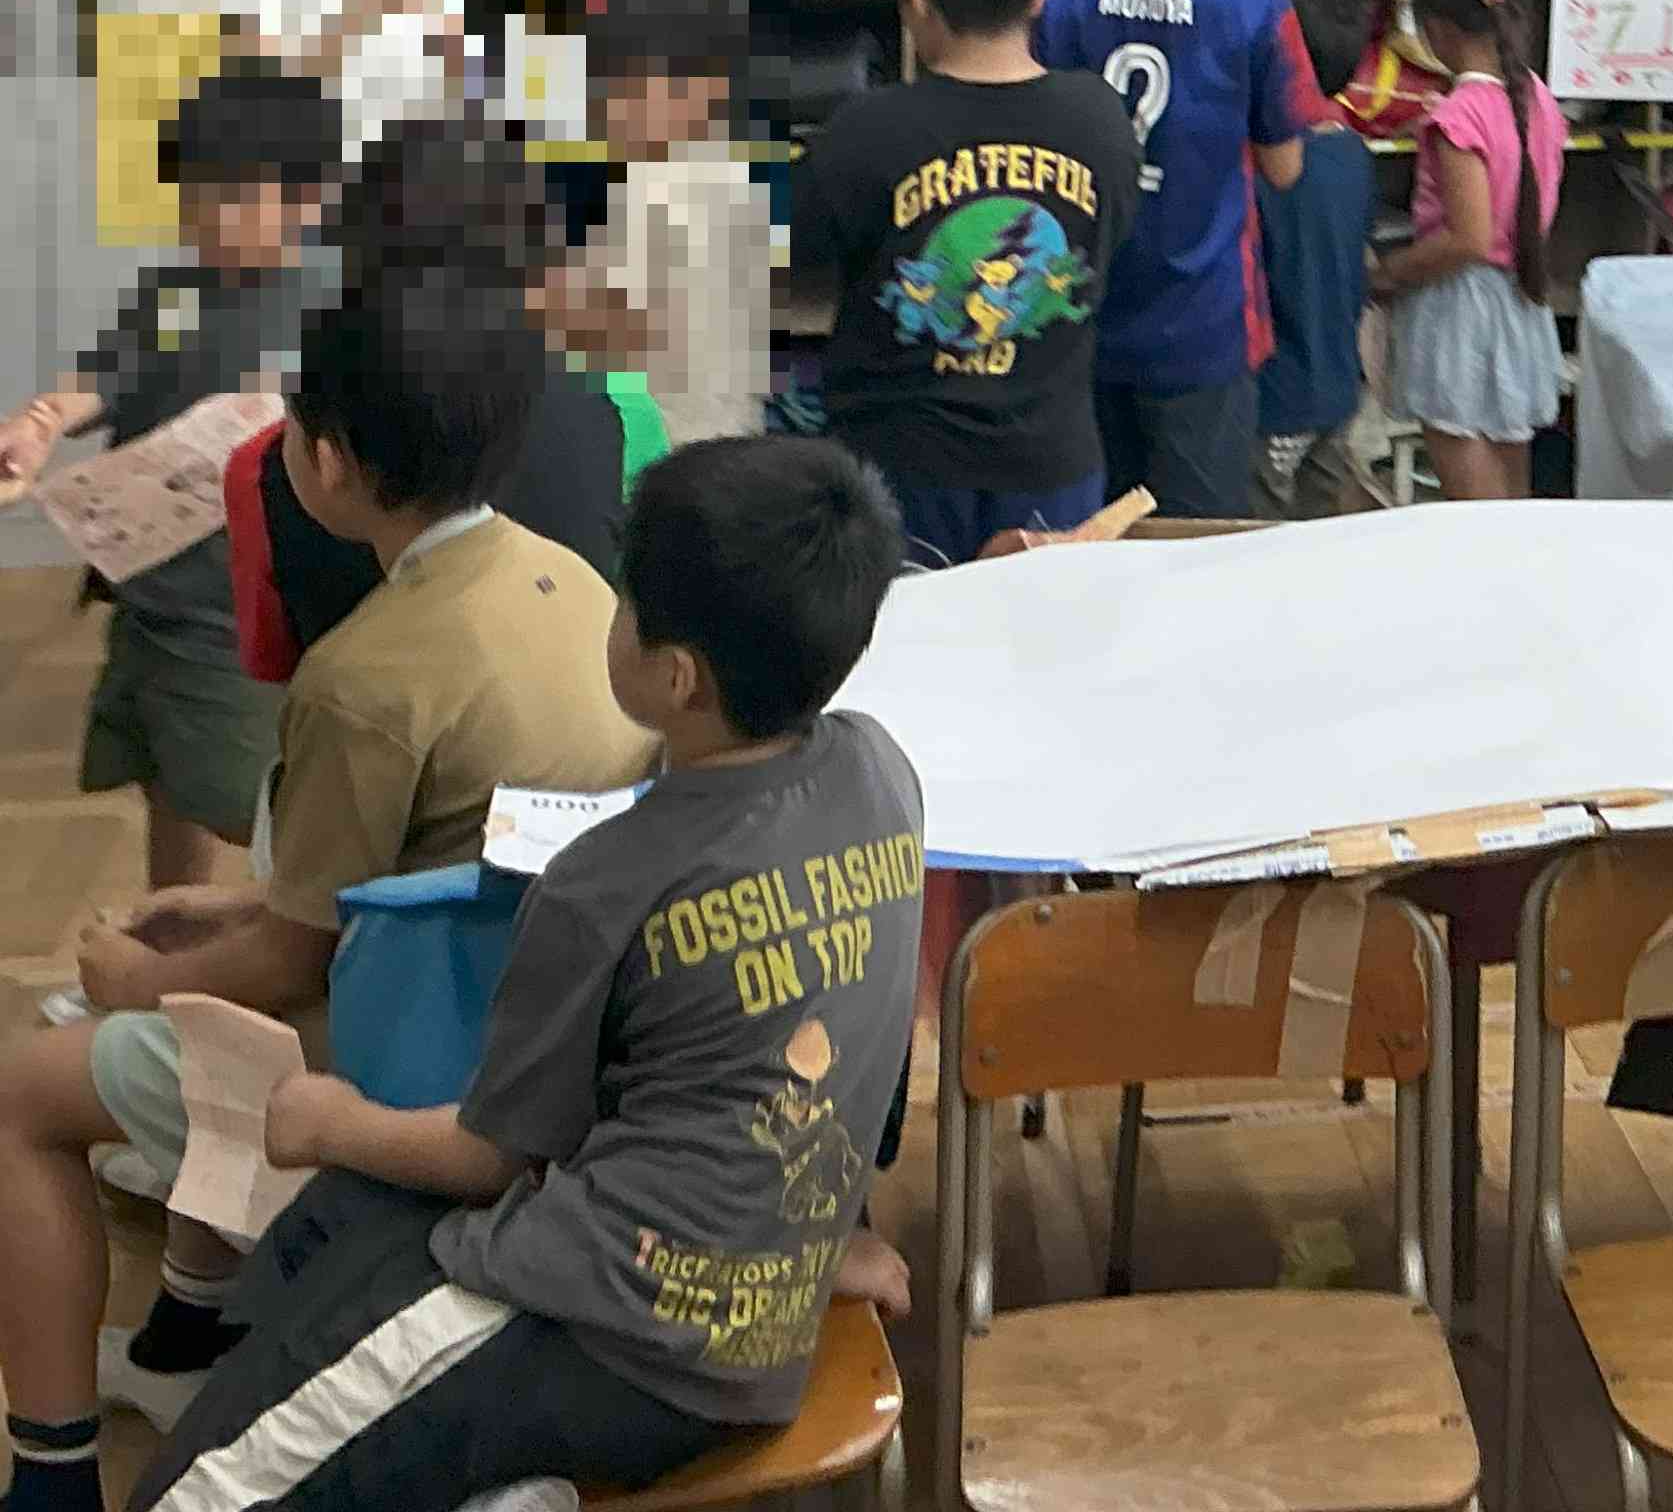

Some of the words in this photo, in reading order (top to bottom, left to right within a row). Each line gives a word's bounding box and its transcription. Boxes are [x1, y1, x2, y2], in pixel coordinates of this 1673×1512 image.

[893, 143, 1098, 230] GRATEFUL
[643, 868, 808, 979] FOSSIL
[804, 831, 923, 920] FASHIO
[734, 939, 804, 1016] ON
[807, 915, 872, 990] TOP
